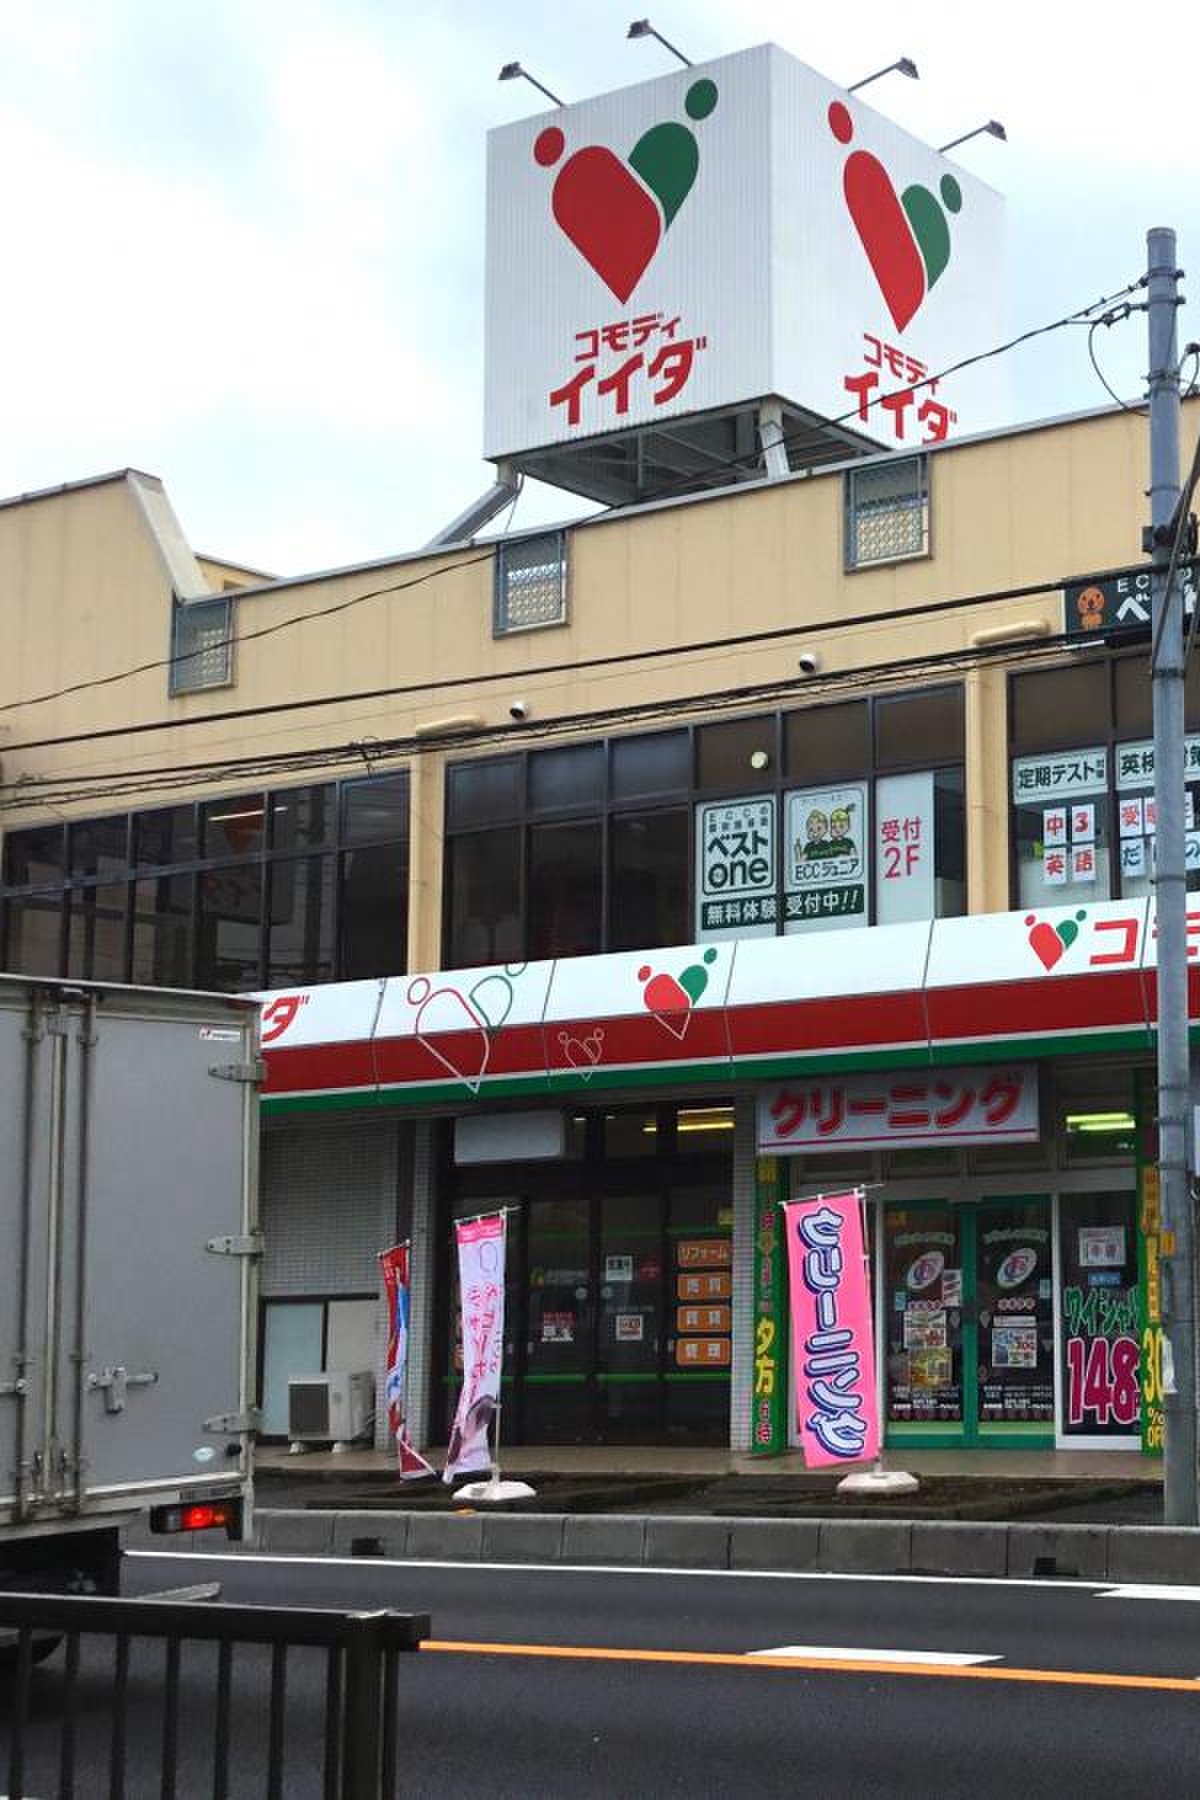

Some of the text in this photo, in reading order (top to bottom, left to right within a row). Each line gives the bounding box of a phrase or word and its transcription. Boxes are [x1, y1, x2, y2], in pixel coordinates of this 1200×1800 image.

[575, 312, 681, 362] コモディ
[864, 333, 939, 394] コモディ
[549, 338, 707, 425] イイダ
[844, 371, 958, 444] イイダ
[707, 820, 769, 858] ベスト
[881, 816, 921, 844] 受付
[707, 858, 769, 889] one
[884, 843, 922, 880] 2F
[770, 1071, 1025, 1137] クリーニング
[800, 1206, 867, 1457] クリーニング
[1067, 1337, 1140, 1425] 148
